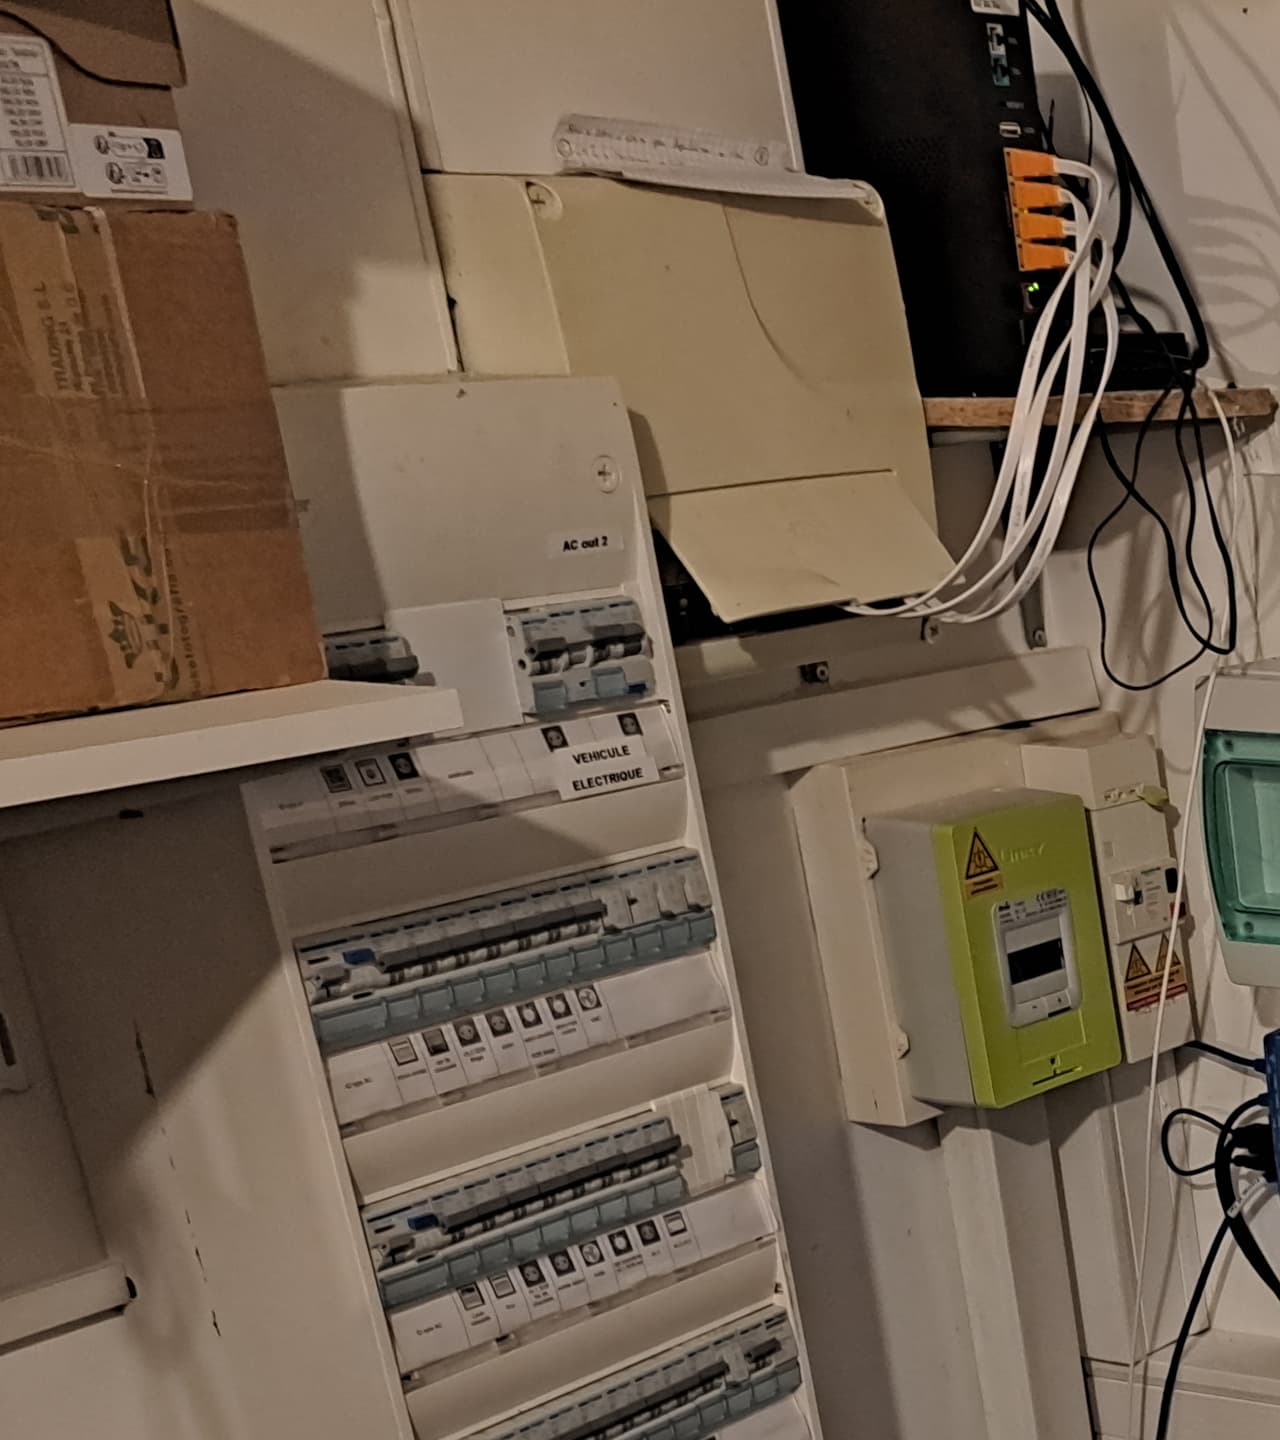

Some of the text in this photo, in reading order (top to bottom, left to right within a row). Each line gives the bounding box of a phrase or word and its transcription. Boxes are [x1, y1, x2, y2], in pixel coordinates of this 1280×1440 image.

[563, 535, 608, 552] AC out 2
[572, 744, 631, 765] VEHICULE
[572, 767, 644, 791] ELECTRIQUE
